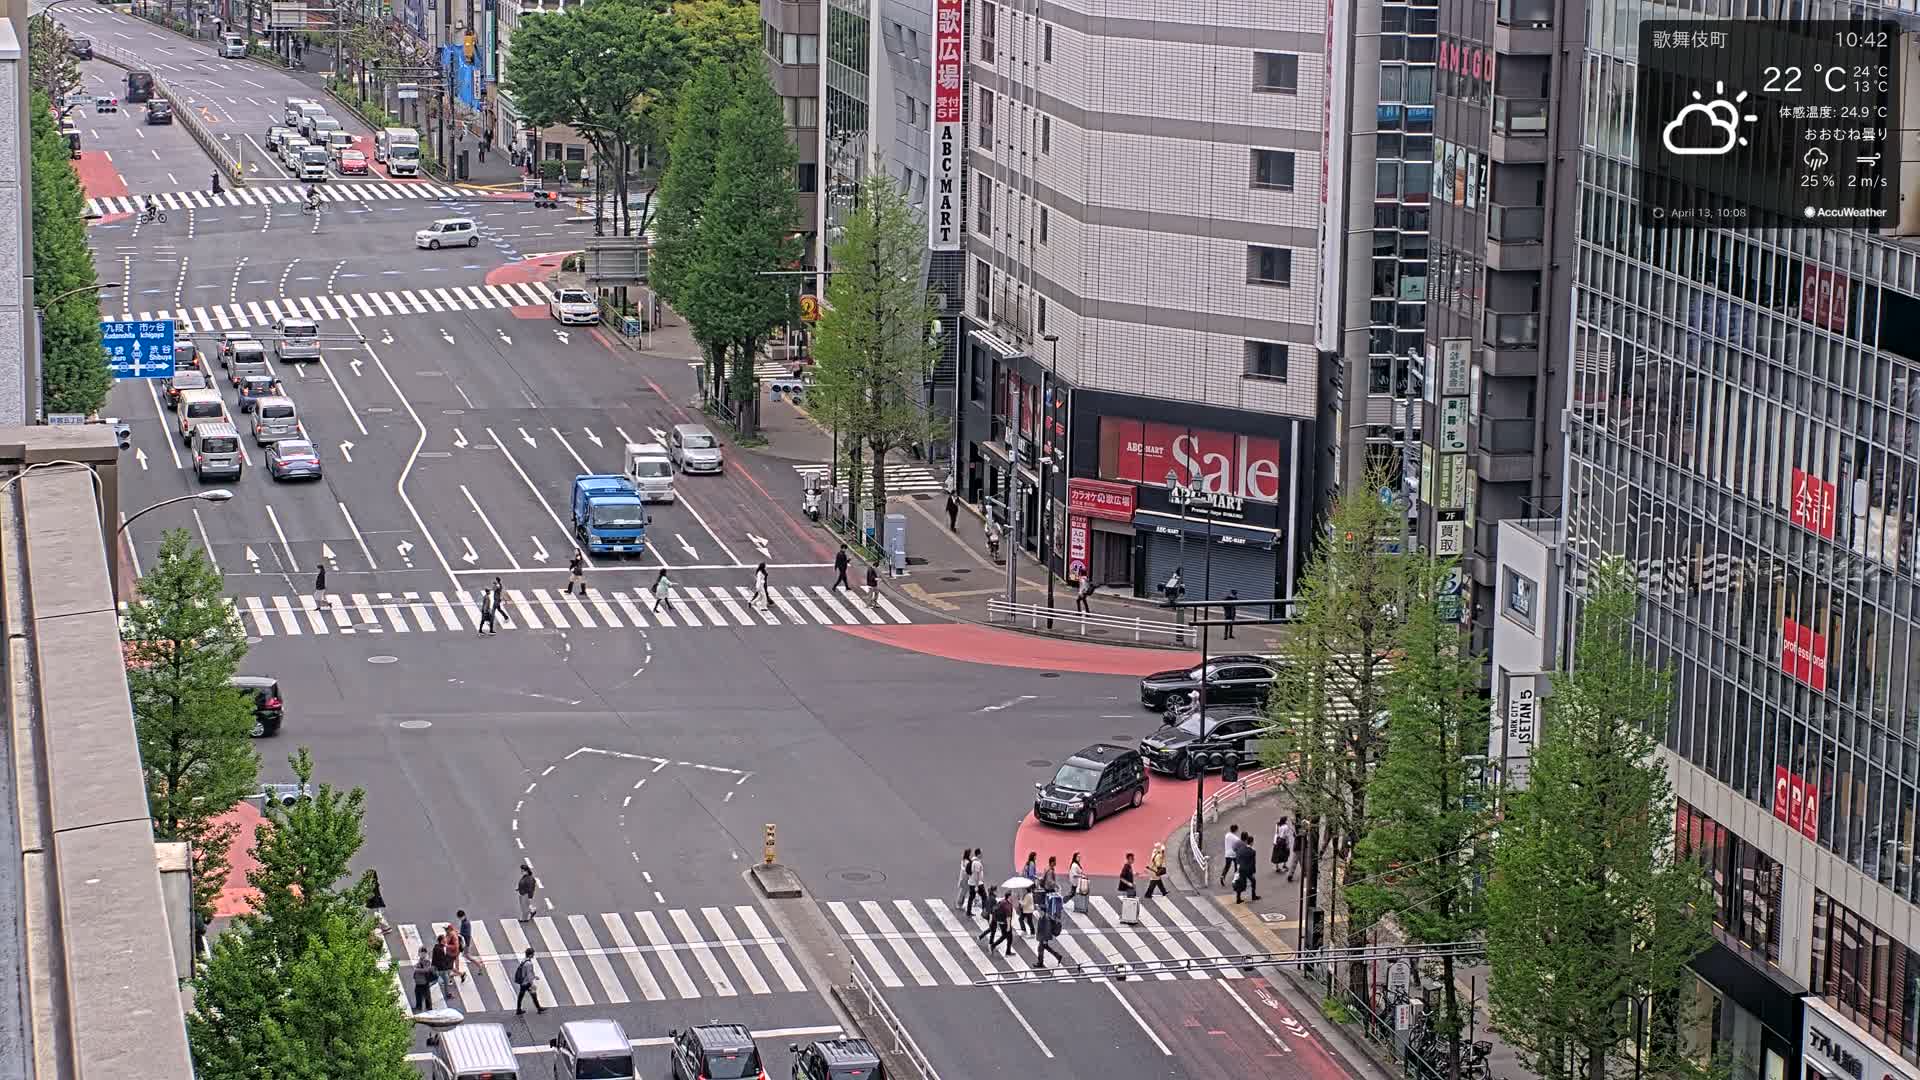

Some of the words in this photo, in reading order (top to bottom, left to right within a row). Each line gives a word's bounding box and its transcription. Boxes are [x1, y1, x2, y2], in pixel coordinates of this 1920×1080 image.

[938, 0, 960, 89] 歌広場
[1439, 40, 1491, 81] AMIGO
[937, 96, 959, 108] 受付
[937, 109, 958, 118] 5F
[1805, 275, 1845, 317] CPA
[105, 323, 134, 333] 九段下
[149, 345, 172, 354] 渋谷
[1171, 434, 1279, 500] Sale
[1445, 512, 1456, 520] 7F
[1795, 480, 1832, 529] 会計
[1440, 524, 1454, 552] 買取
[1511, 700, 1519, 718] CITY
[1518, 702, 1532, 744] ISETAN
[1510, 719, 1518, 738] PARK
[1776, 777, 1815, 827] CPA
